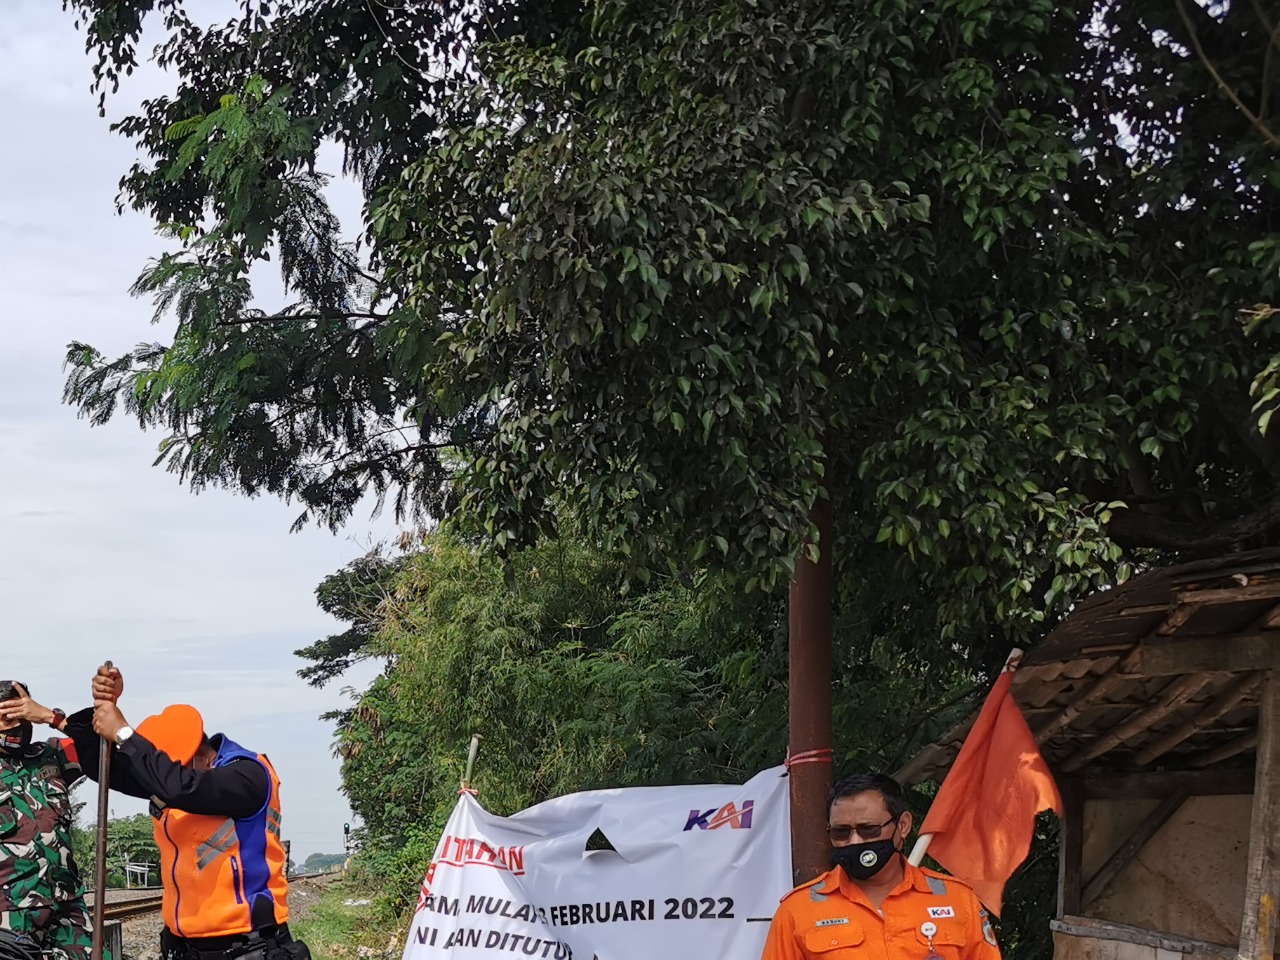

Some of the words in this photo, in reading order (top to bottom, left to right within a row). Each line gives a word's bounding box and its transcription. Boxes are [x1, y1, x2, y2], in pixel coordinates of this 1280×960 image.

[683, 799, 755, 831] KAI
[550, 899, 655, 926] FEBRUARI
[663, 896, 735, 920] 2022
[931, 908, 951, 917] KAI
